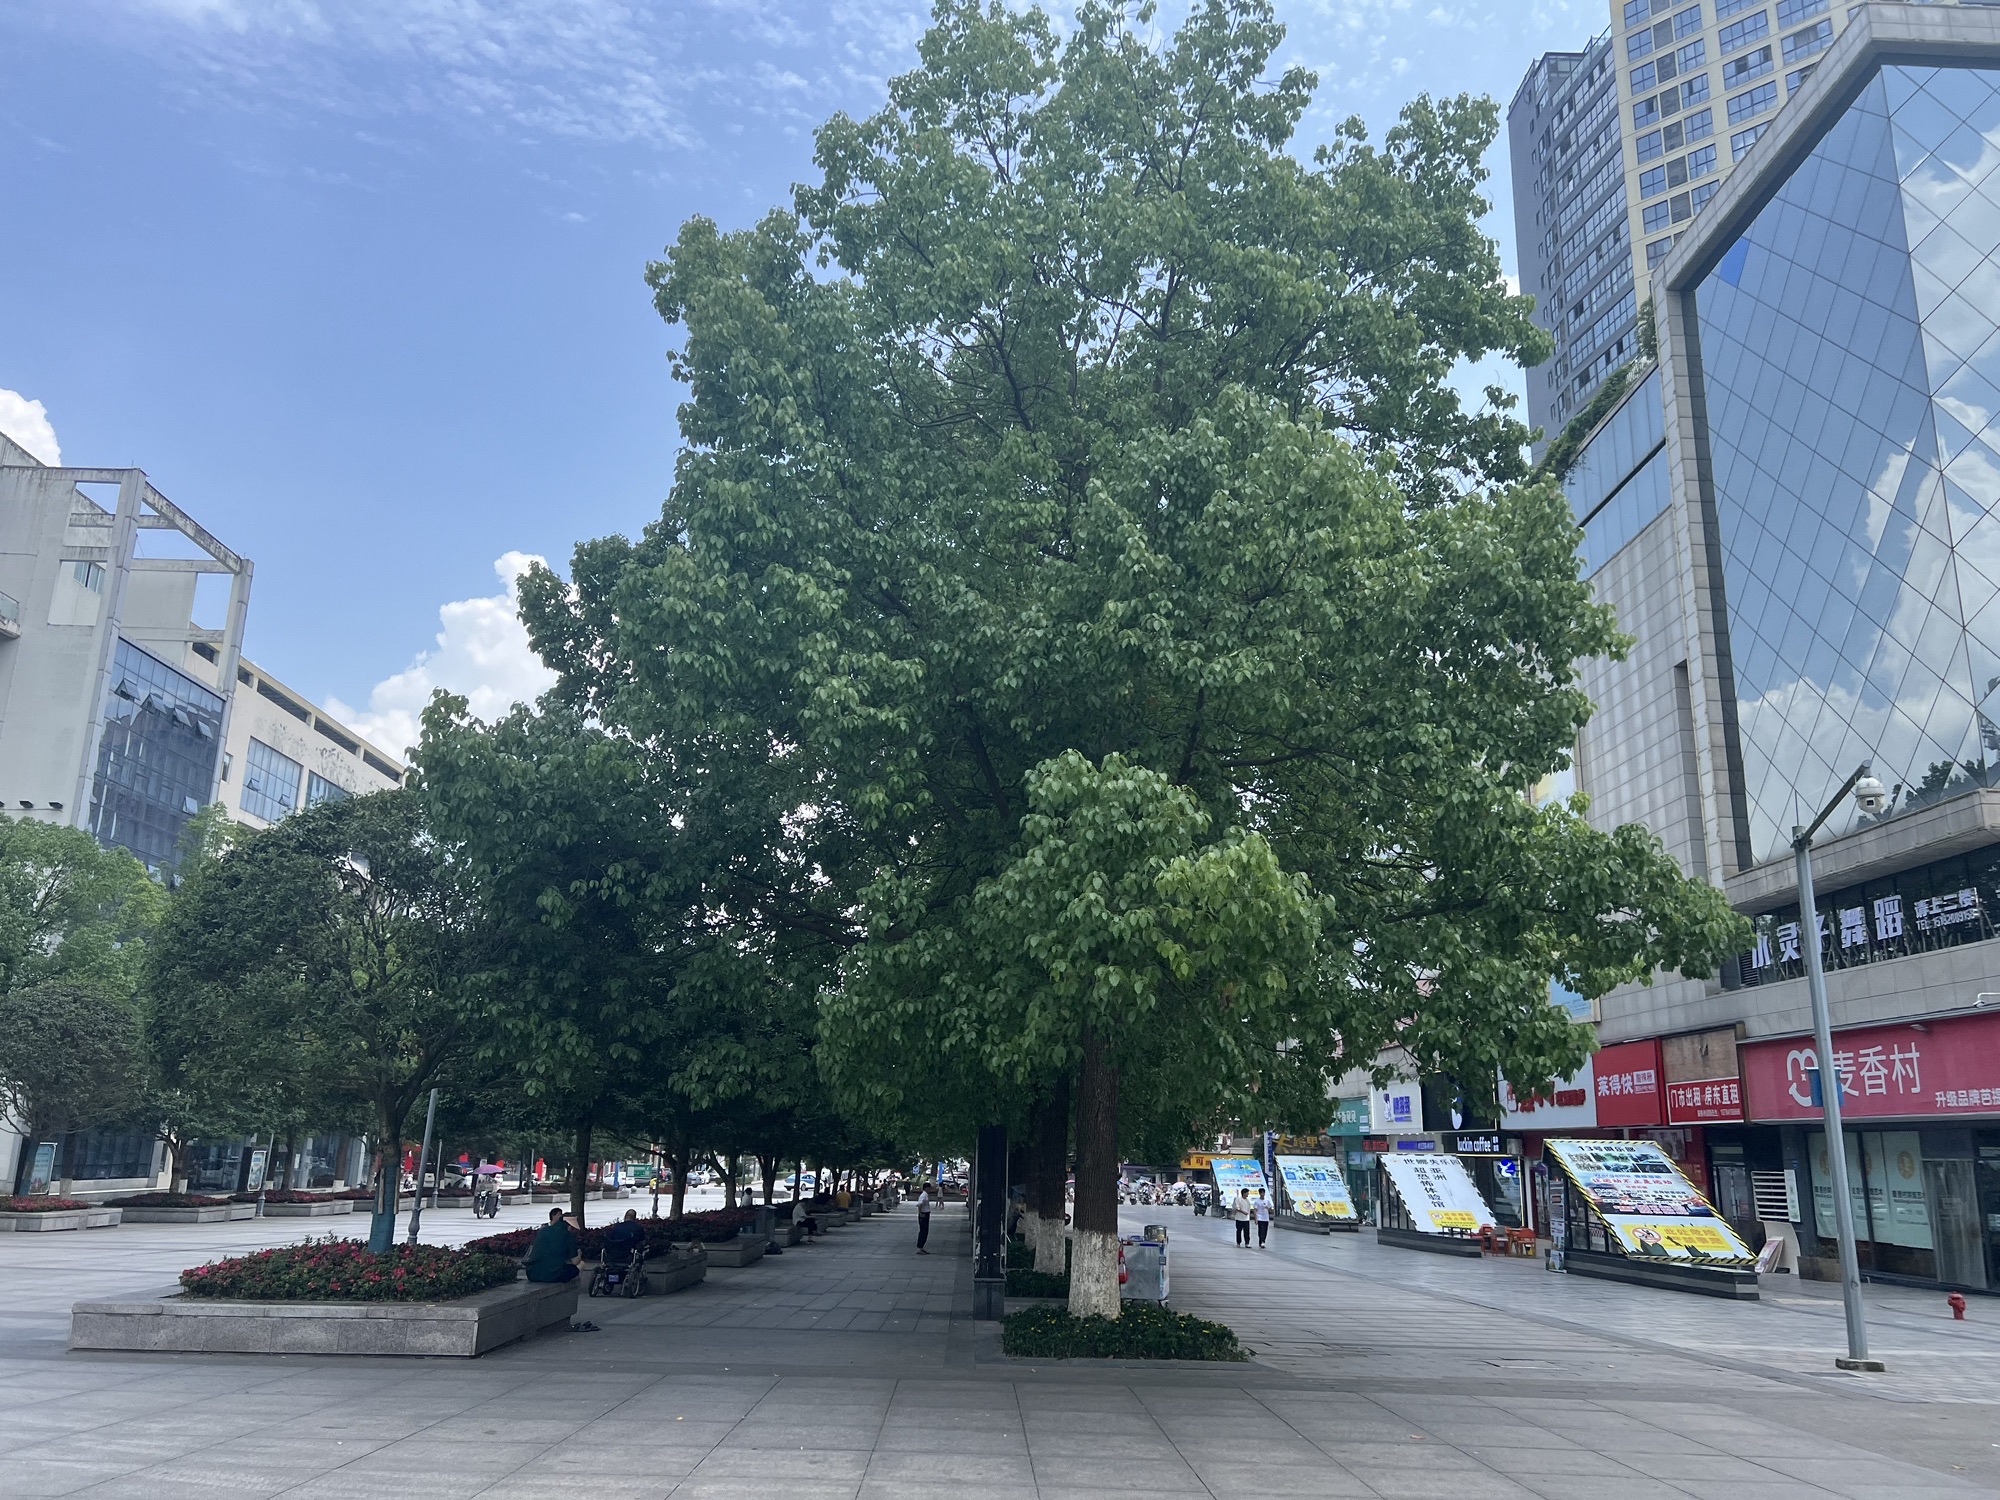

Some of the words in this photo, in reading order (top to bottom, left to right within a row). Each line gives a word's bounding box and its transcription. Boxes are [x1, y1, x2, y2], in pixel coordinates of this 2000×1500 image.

[1833, 1042, 1920, 1096] 麦香村
[1597, 1073, 1633, 1096] 莱得快
[1671, 1087, 1701, 1108] 门市出租
[1705, 1084, 1739, 1105] 房东直租
[1457, 1137, 1473, 1151] luckin
[1474, 1136, 1491, 1152] coffee
[1430, 1167, 1447, 1180] 亚洲
